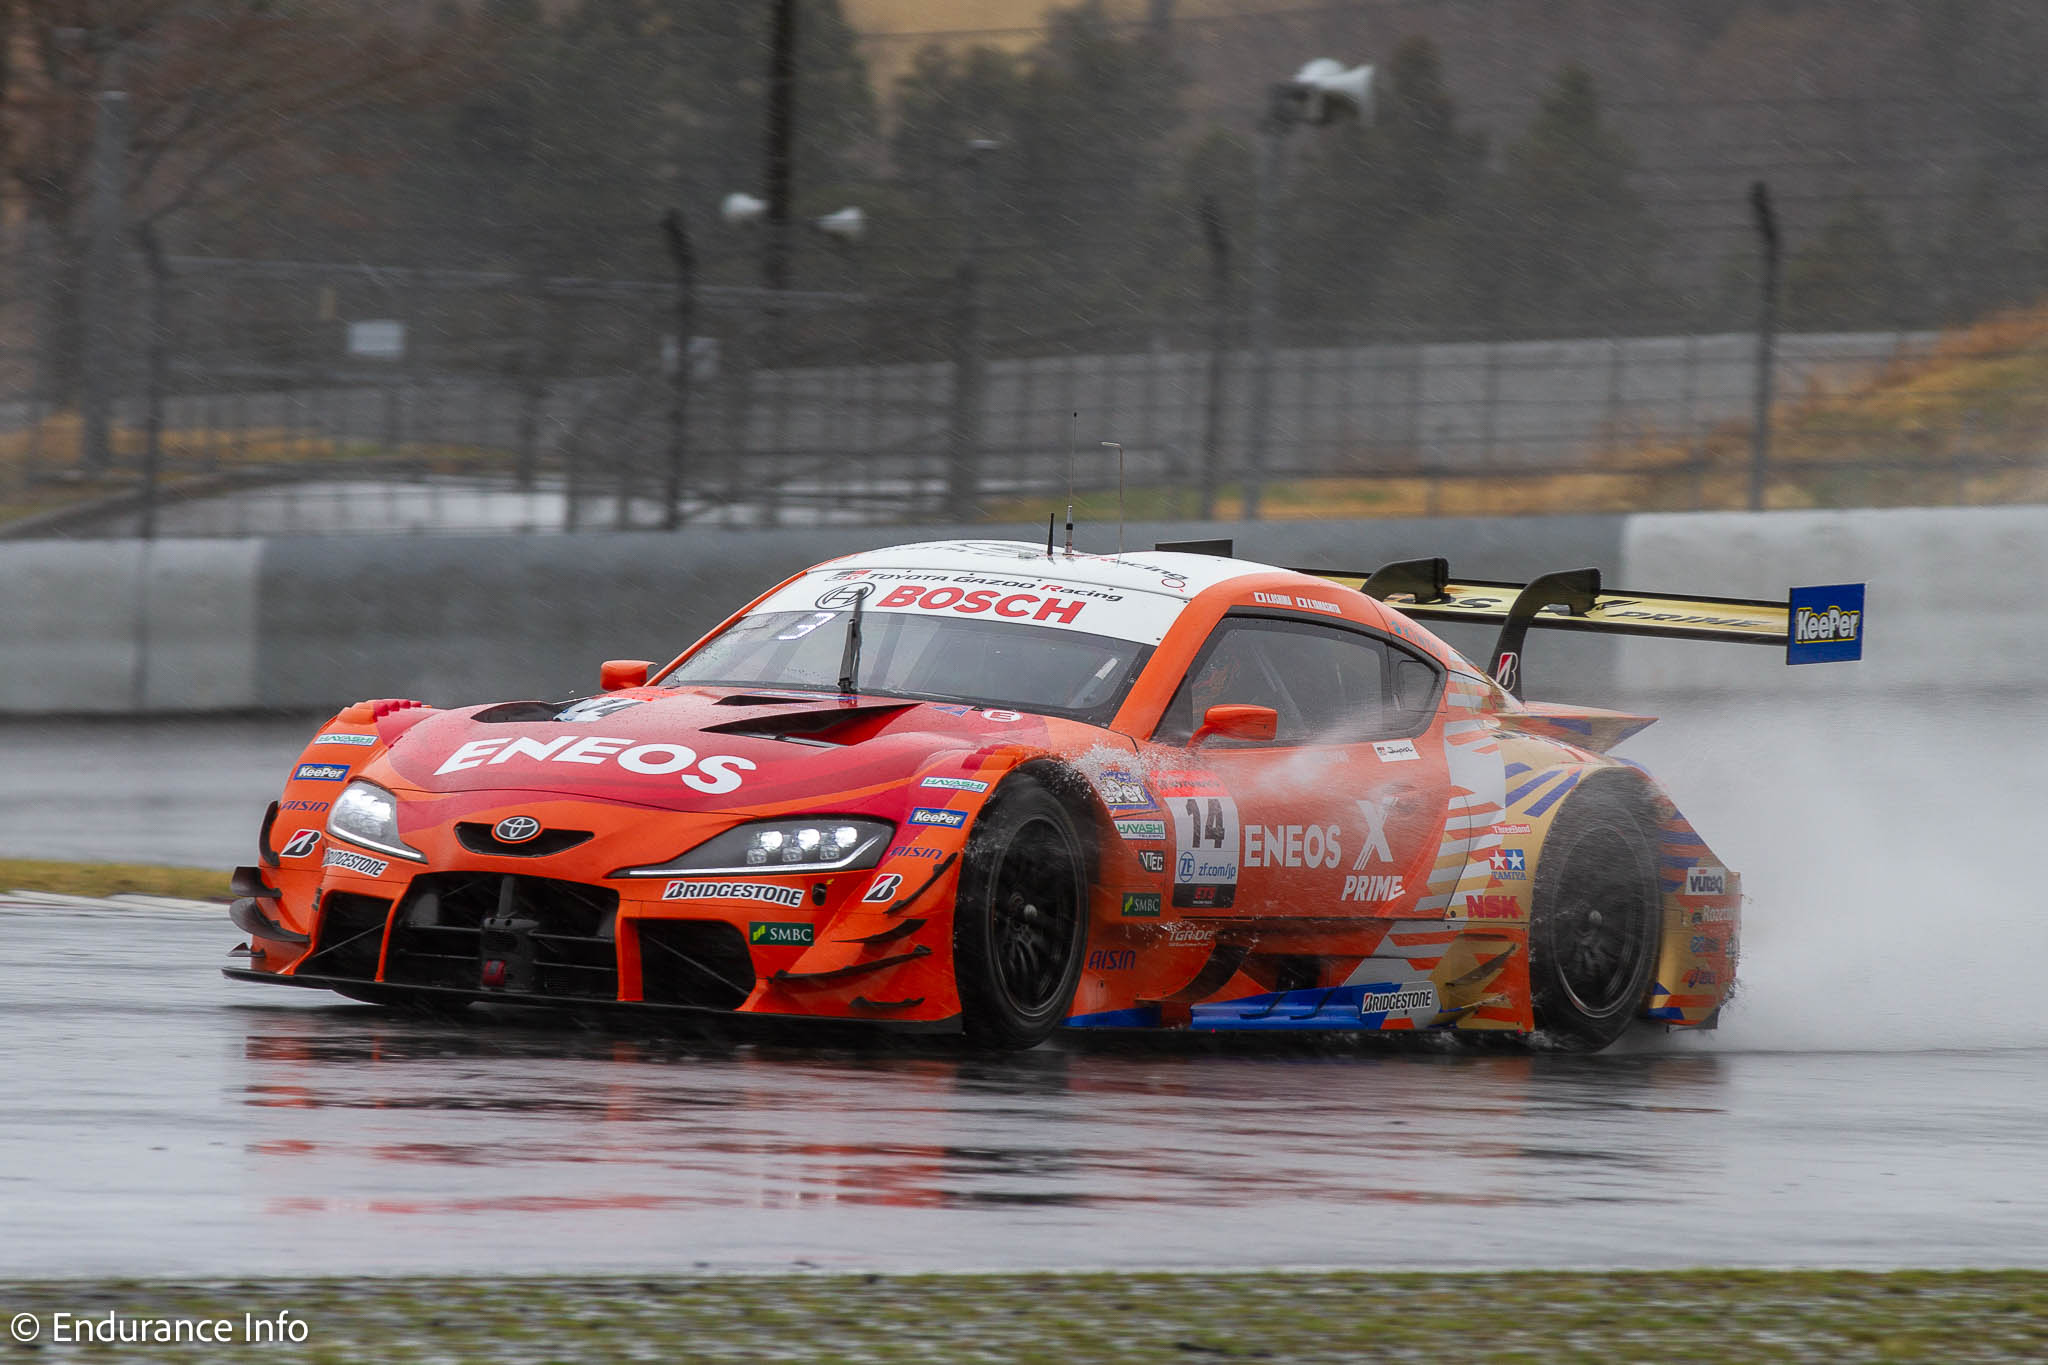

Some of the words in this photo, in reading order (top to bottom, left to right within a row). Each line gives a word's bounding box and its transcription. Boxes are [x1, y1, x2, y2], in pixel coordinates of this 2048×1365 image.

[868, 573, 949, 581] TOYOTA
[953, 575, 1037, 589] GAZOO
[1040, 584, 1124, 602] Racing
[876, 585, 1087, 625] BOSCH
[1606, 611, 1774, 628] PRIME
[1796, 607, 1859, 642] KeePer
[319, 735, 375, 744] HAYASHI
[297, 766, 346, 780] KeePer
[433, 736, 757, 795] ENEOS
[925, 778, 985, 790] HAYASHI
[280, 800, 331, 813] AISIN
[912, 810, 963, 826] KeePer
[1186, 799, 1225, 849] 14
[1117, 823, 1164, 834] HAYASHI
[1243, 824, 1341, 869] ENEOS
[1352, 797, 1401, 871] X
[889, 846, 943, 860] AISIN
[1198, 863, 1237, 879] zf.com/jp
[1493, 872, 1527, 880] TAMIYA
[663, 881, 803, 907] BRIDGESTONE
[1340, 875, 1406, 902] PRIME
[1133, 898, 1160, 912] SMBC
[1466, 895, 1521, 918] NSK
[769, 927, 812, 942] SMBC
[1088, 950, 1136, 969] AISIN
[1362, 990, 1432, 1013] BRIDGESTONE
